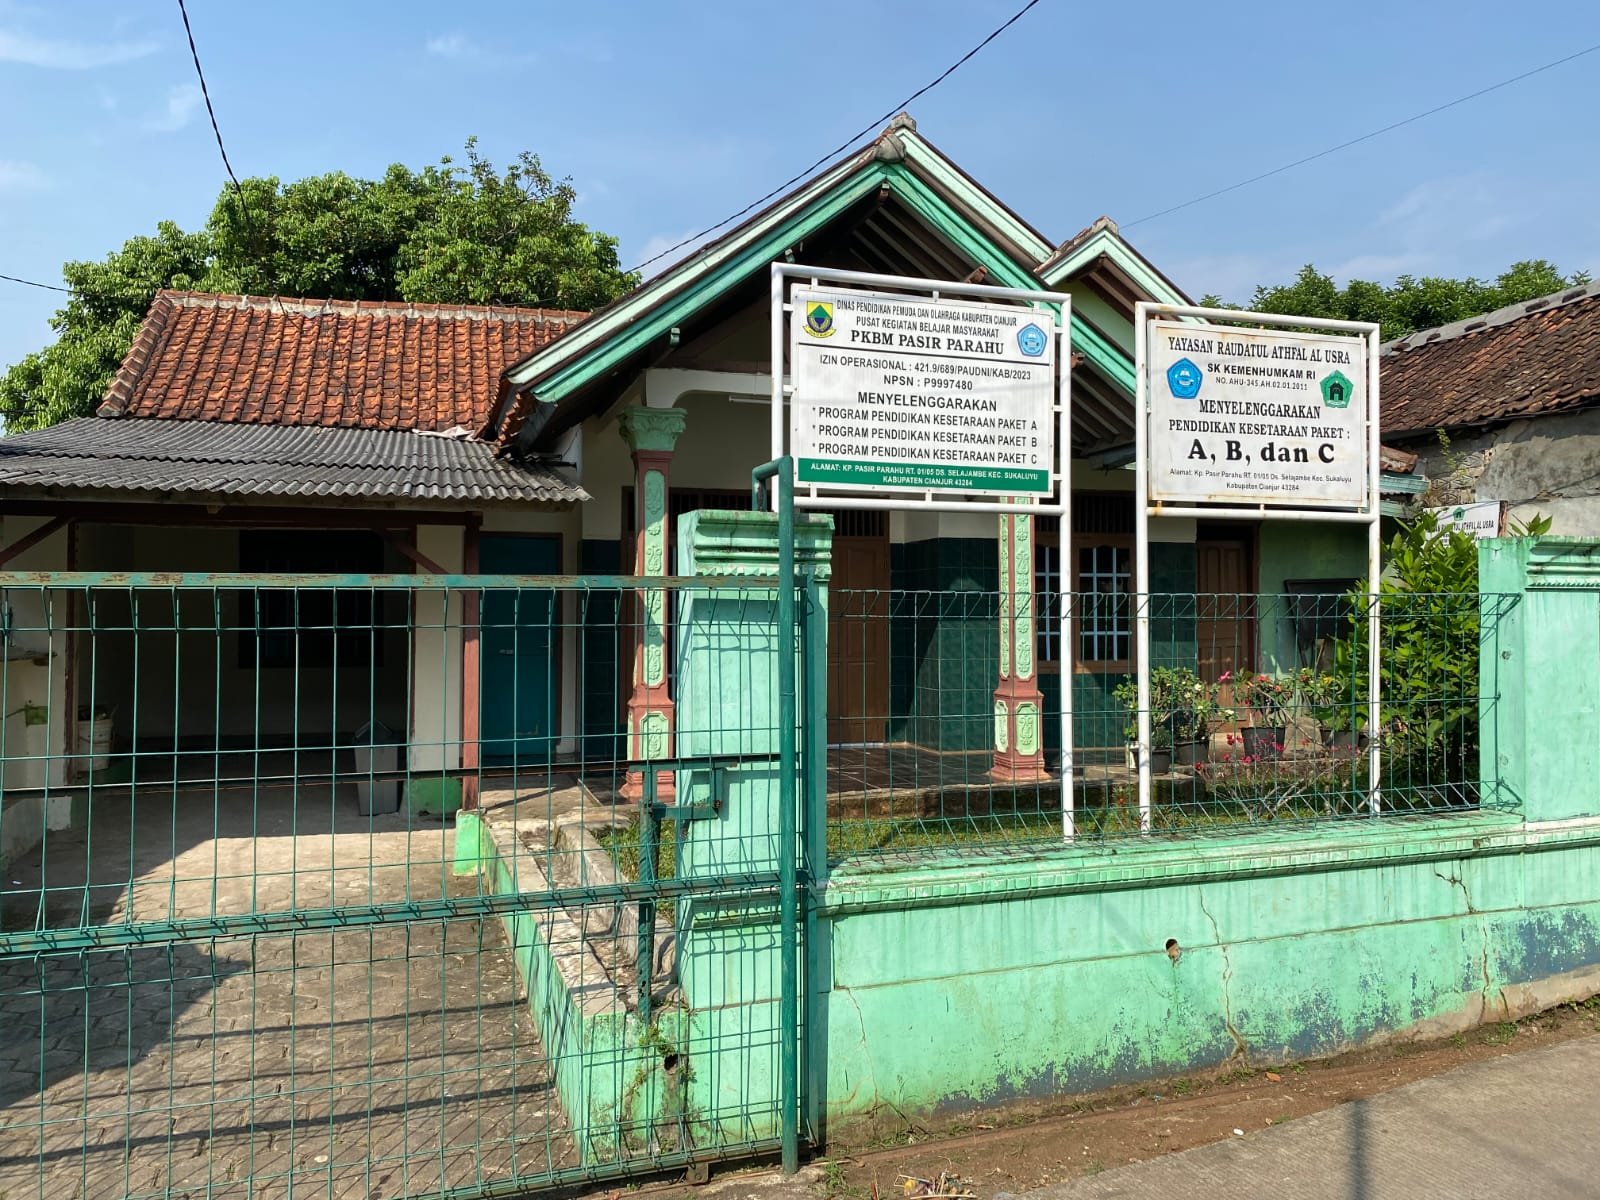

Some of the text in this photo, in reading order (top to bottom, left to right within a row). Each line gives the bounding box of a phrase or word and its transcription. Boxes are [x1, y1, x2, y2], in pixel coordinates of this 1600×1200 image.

[837, 300, 1016, 326] DINAS PENDIDIKAN PEMUDA DAN OLAHRAGA KABUPATEN CIANJUR
[856, 316, 999, 338] PUSAT KEGIATAN BELAJAR MASYARAKAT
[851, 330, 893, 345] PKBM
[899, 334, 941, 349] PASIR
[947, 338, 1004, 354] PARAHU
[1168, 337, 1350, 364] YAYASAN RAUDATUL ATHFAL AL USRA
[820, 354, 837, 365] IZIN
[840, 356, 906, 370] OPERASIONAL
[914, 362, 1031, 380] 421.9/689/PAUDNI/KAB/2023
[1208, 363, 1316, 379] SK KEMENHUMKAM RI
[883, 375, 914, 386] NPSN
[924, 378, 972, 390] P9997480
[1216, 377, 1228, 385] NO.
[858, 391, 997, 412] MENYELENGGARAKAN
[1200, 399, 1321, 419] MENYELENGGARAKAN
[819, 407, 1037, 430] PROGRAM PENDIDIKAN KESETARAAN PAKET A
[1169, 419, 1236, 433] PENDIDIKAN
[1239, 422, 1308, 437] KESETARAAN
[1311, 426, 1343, 438] PAKET
[819, 425, 1037, 447] PROGRAM PENDIDIKAN KESETARAAN PAKET B
[819, 443, 1037, 464] PROGRAM PENDIDIKAN KESETARAAN PAKET C
[1188, 439, 1334, 466] A, B, dan C
[811, 463, 840, 471] ALAMAT:
[877, 466, 904, 474] PARAHU
[948, 470, 986, 478] SELAJAMBE
[1005, 472, 1038, 480] SUKALUYU
[883, 476, 922, 484] KABUPATEN
[1326, 475, 1351, 483] Sukaluyu
[1227, 482, 1257, 490] Kabupaten
